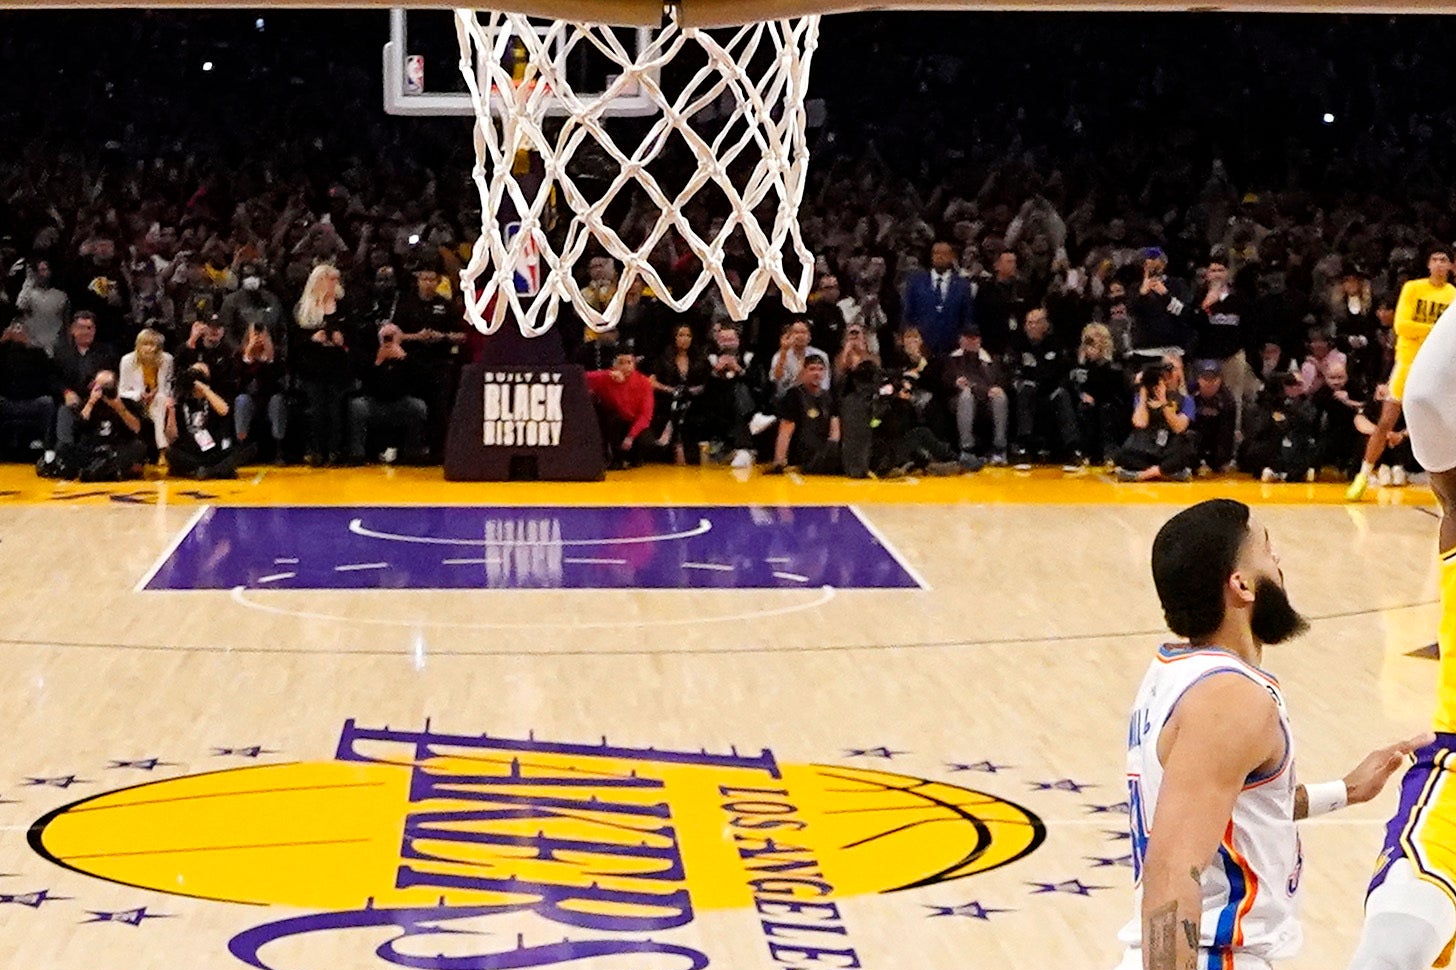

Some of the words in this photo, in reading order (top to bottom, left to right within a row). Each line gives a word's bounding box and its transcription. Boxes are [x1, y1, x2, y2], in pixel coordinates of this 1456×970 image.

[484, 384, 564, 420] BLACK
[483, 420, 562, 446] HISTORY
[718, 784, 808, 831] LOS
